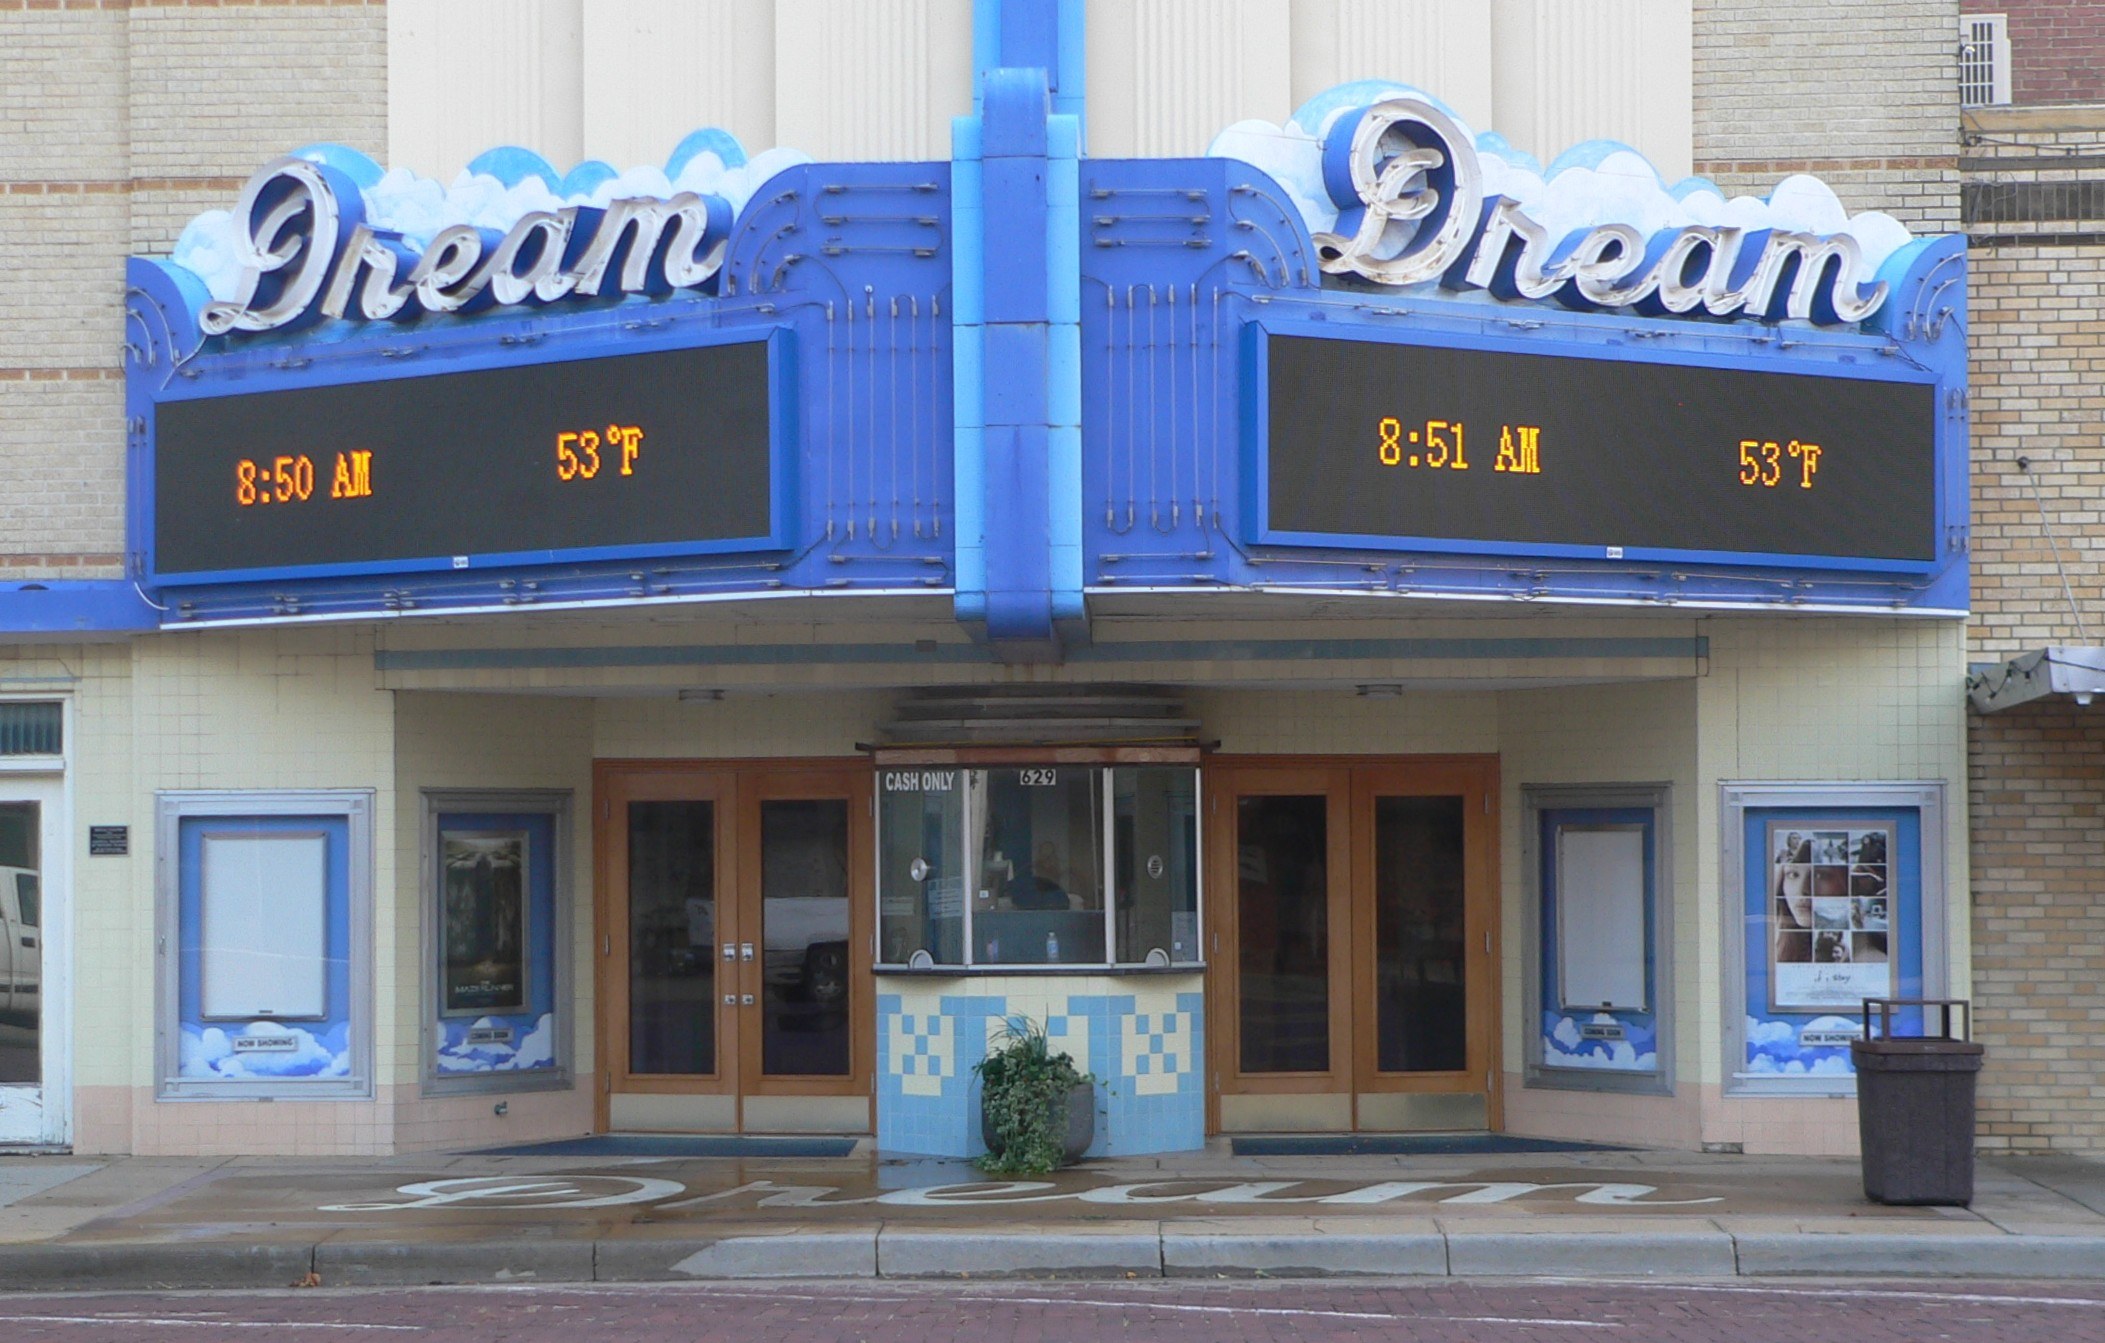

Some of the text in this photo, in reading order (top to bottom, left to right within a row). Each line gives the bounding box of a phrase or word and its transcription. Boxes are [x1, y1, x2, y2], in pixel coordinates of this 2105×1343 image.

[1311, 98, 1890, 326] Dream
[199, 156, 728, 336] Dream
[1378, 417, 1541, 475] 8:51 AM
[235, 450, 373, 506] 8:50 AM
[886, 772, 955, 791] CASH ONLY
[1021, 769, 1054, 785] 629
[237, 1038, 294, 1048] NOW SHOWING
[1803, 1034, 1822, 1042] NOW
